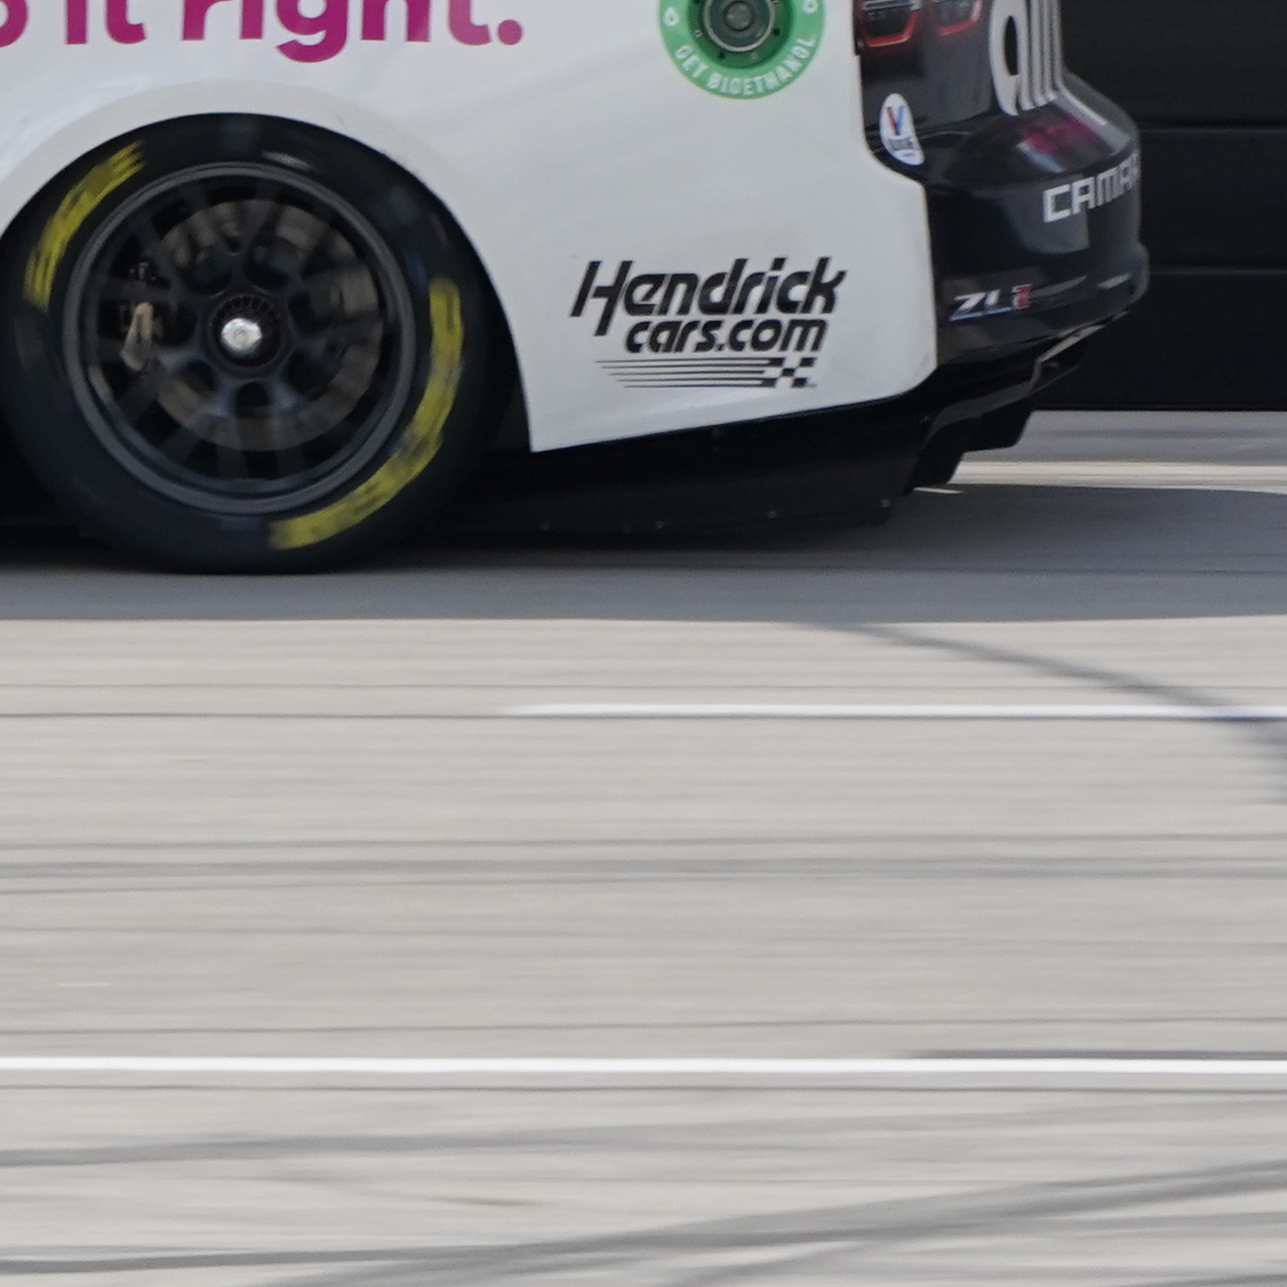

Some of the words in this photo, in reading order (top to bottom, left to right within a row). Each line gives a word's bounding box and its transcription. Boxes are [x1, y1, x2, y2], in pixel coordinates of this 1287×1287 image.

[675, 45, 709, 79] GET
[706, 37, 817, 96] BIOETHANOL
[569, 256, 848, 336] Hendrick
[949, 283, 1033, 322] ZL1
[624, 318, 828, 353] cars.com
